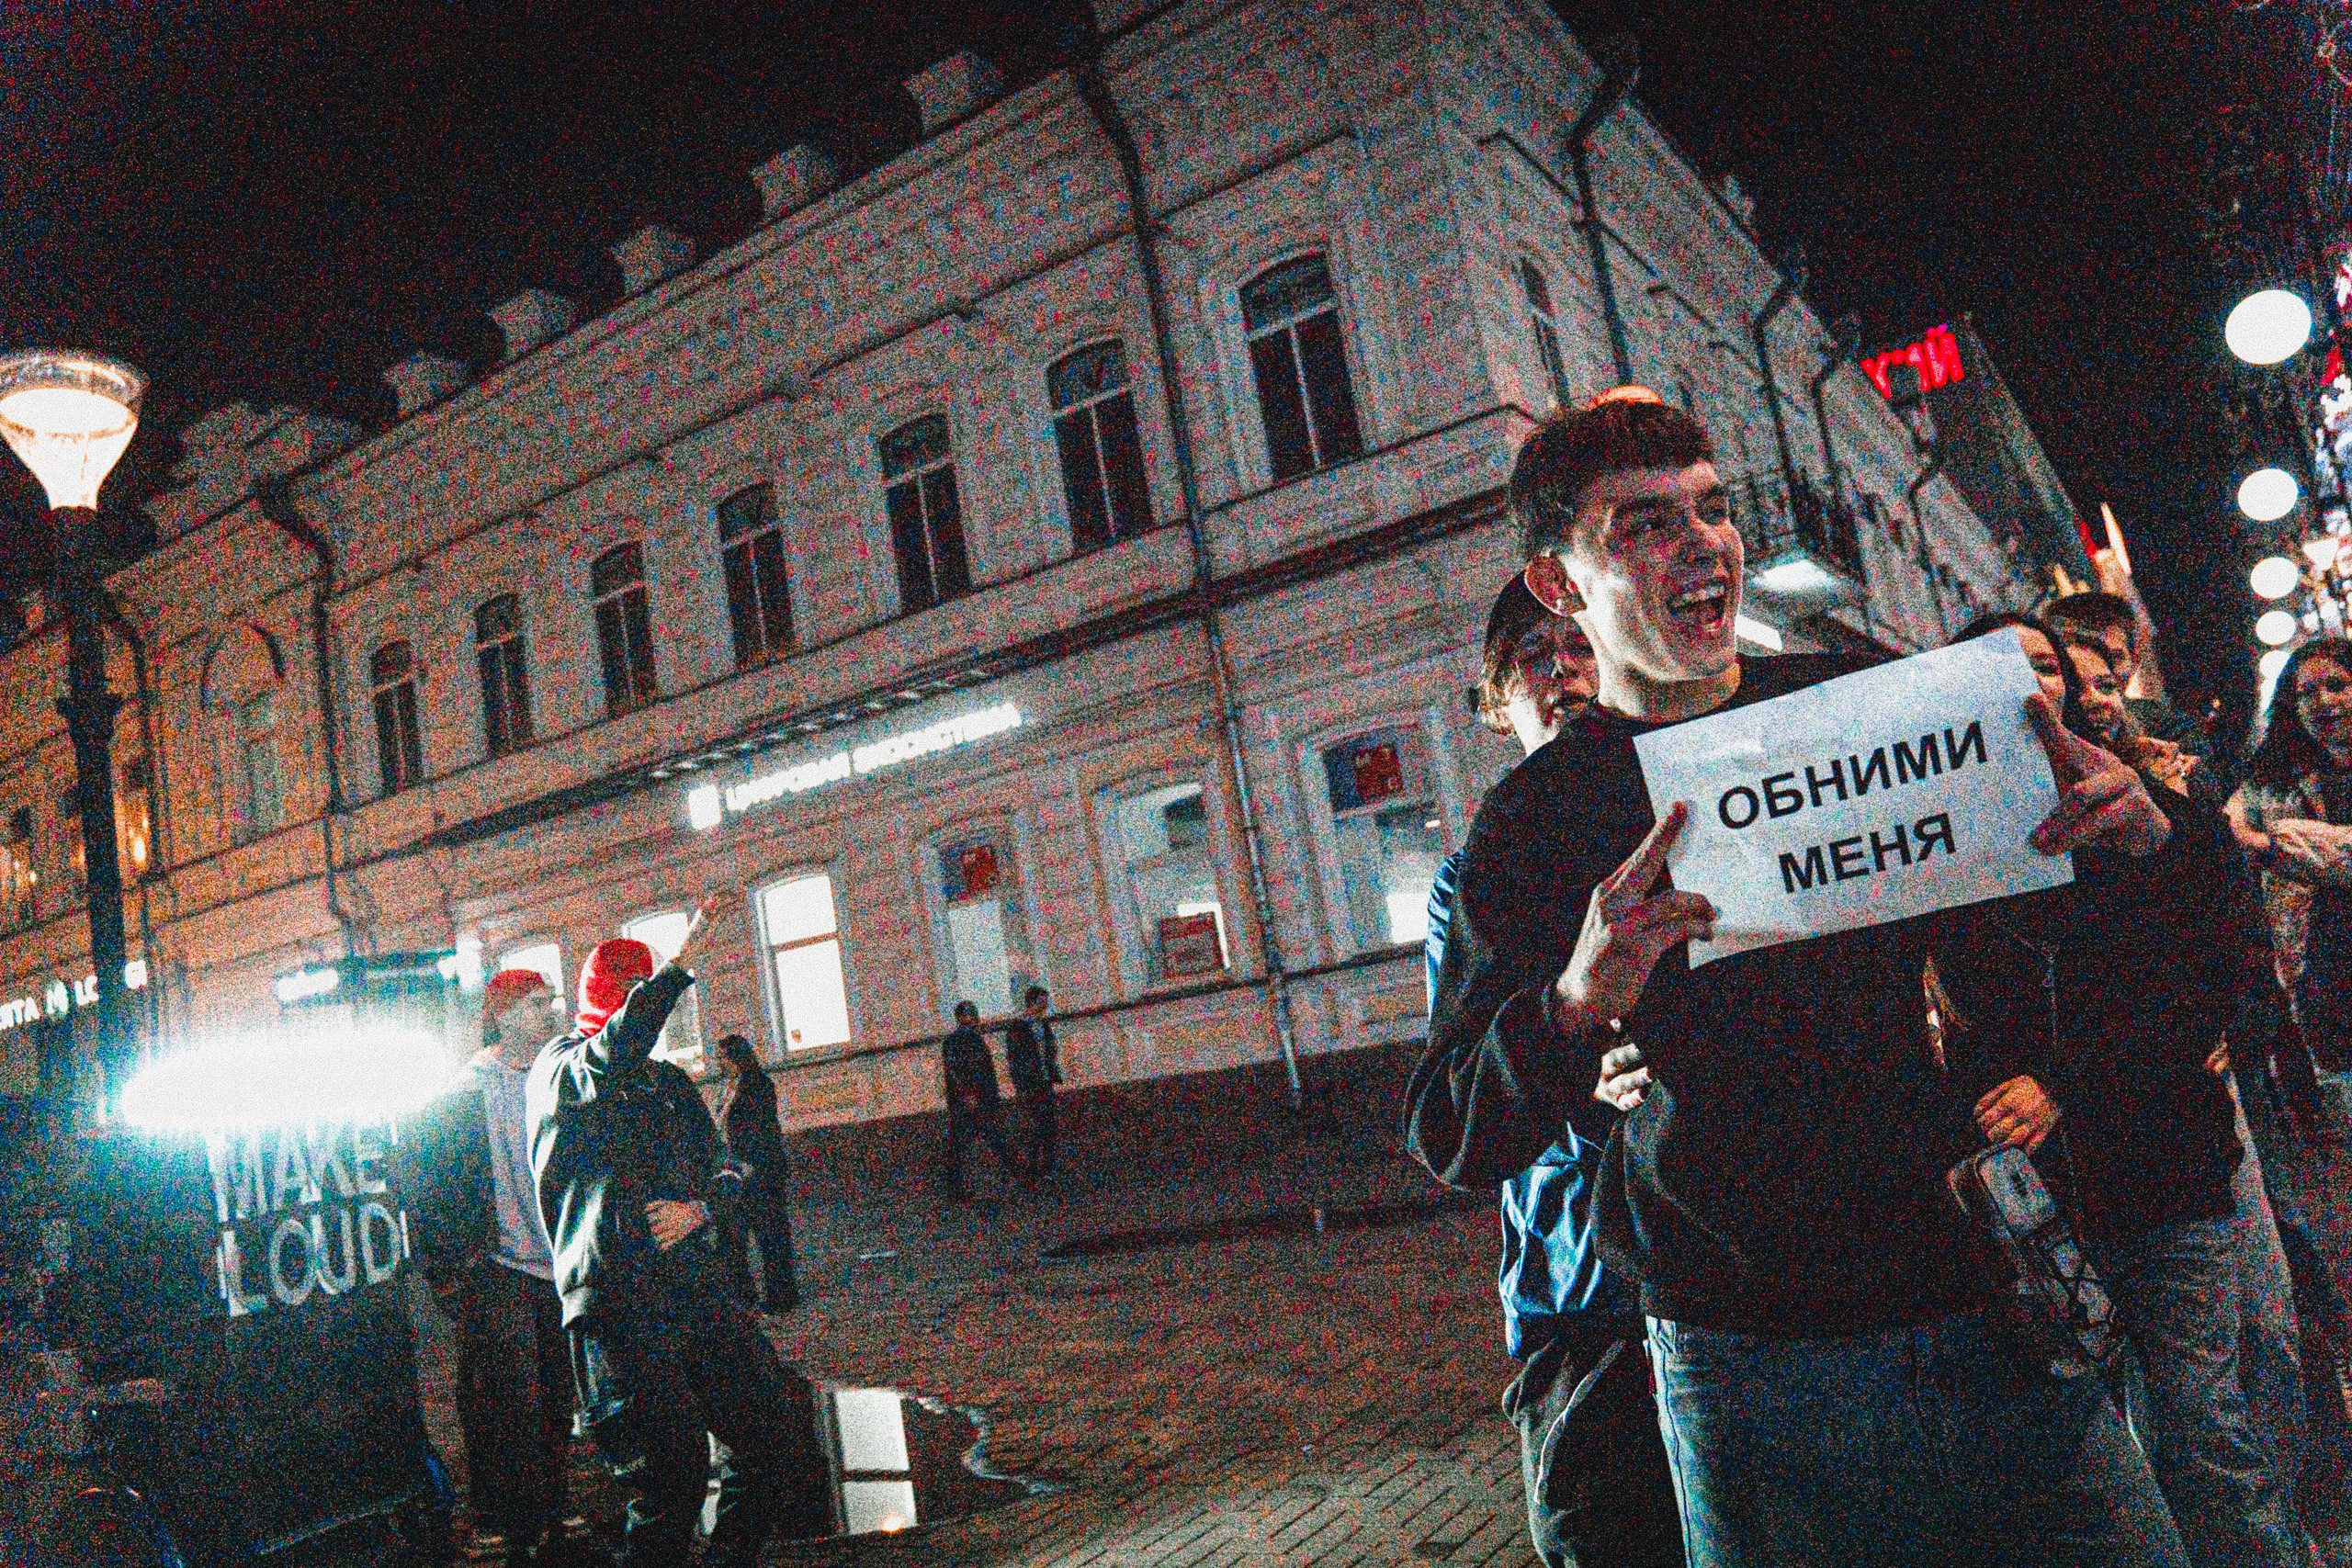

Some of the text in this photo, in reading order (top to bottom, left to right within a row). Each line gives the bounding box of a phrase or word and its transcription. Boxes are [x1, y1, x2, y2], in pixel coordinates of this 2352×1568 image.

[1717, 720, 1988, 830] ОБНИМИ
[1777, 812, 1956, 895] МЕНЯ
[207, 1117, 388, 1223] MAKE
